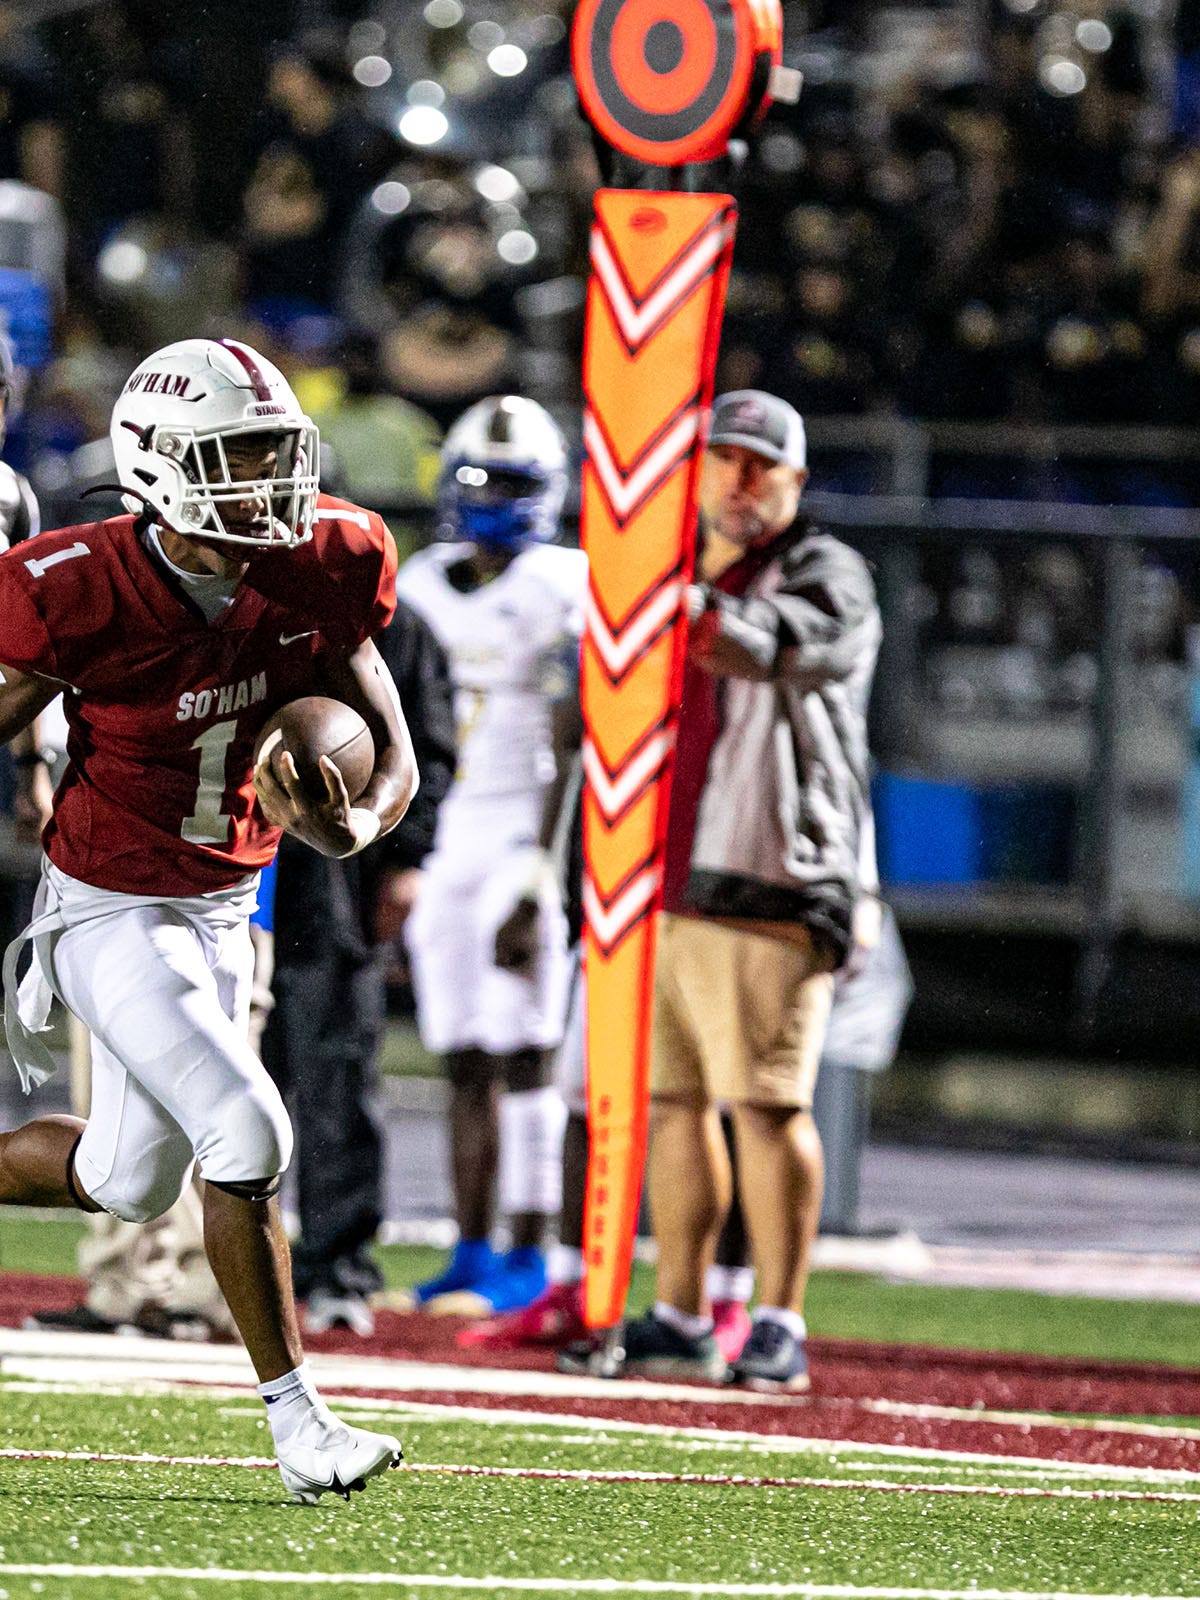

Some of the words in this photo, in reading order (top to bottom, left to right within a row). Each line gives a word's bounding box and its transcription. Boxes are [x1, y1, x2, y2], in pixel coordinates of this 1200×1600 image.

[23, 541, 91, 578] 1
[176, 671, 268, 721] SO'HAM
[180, 719, 238, 844] 1
